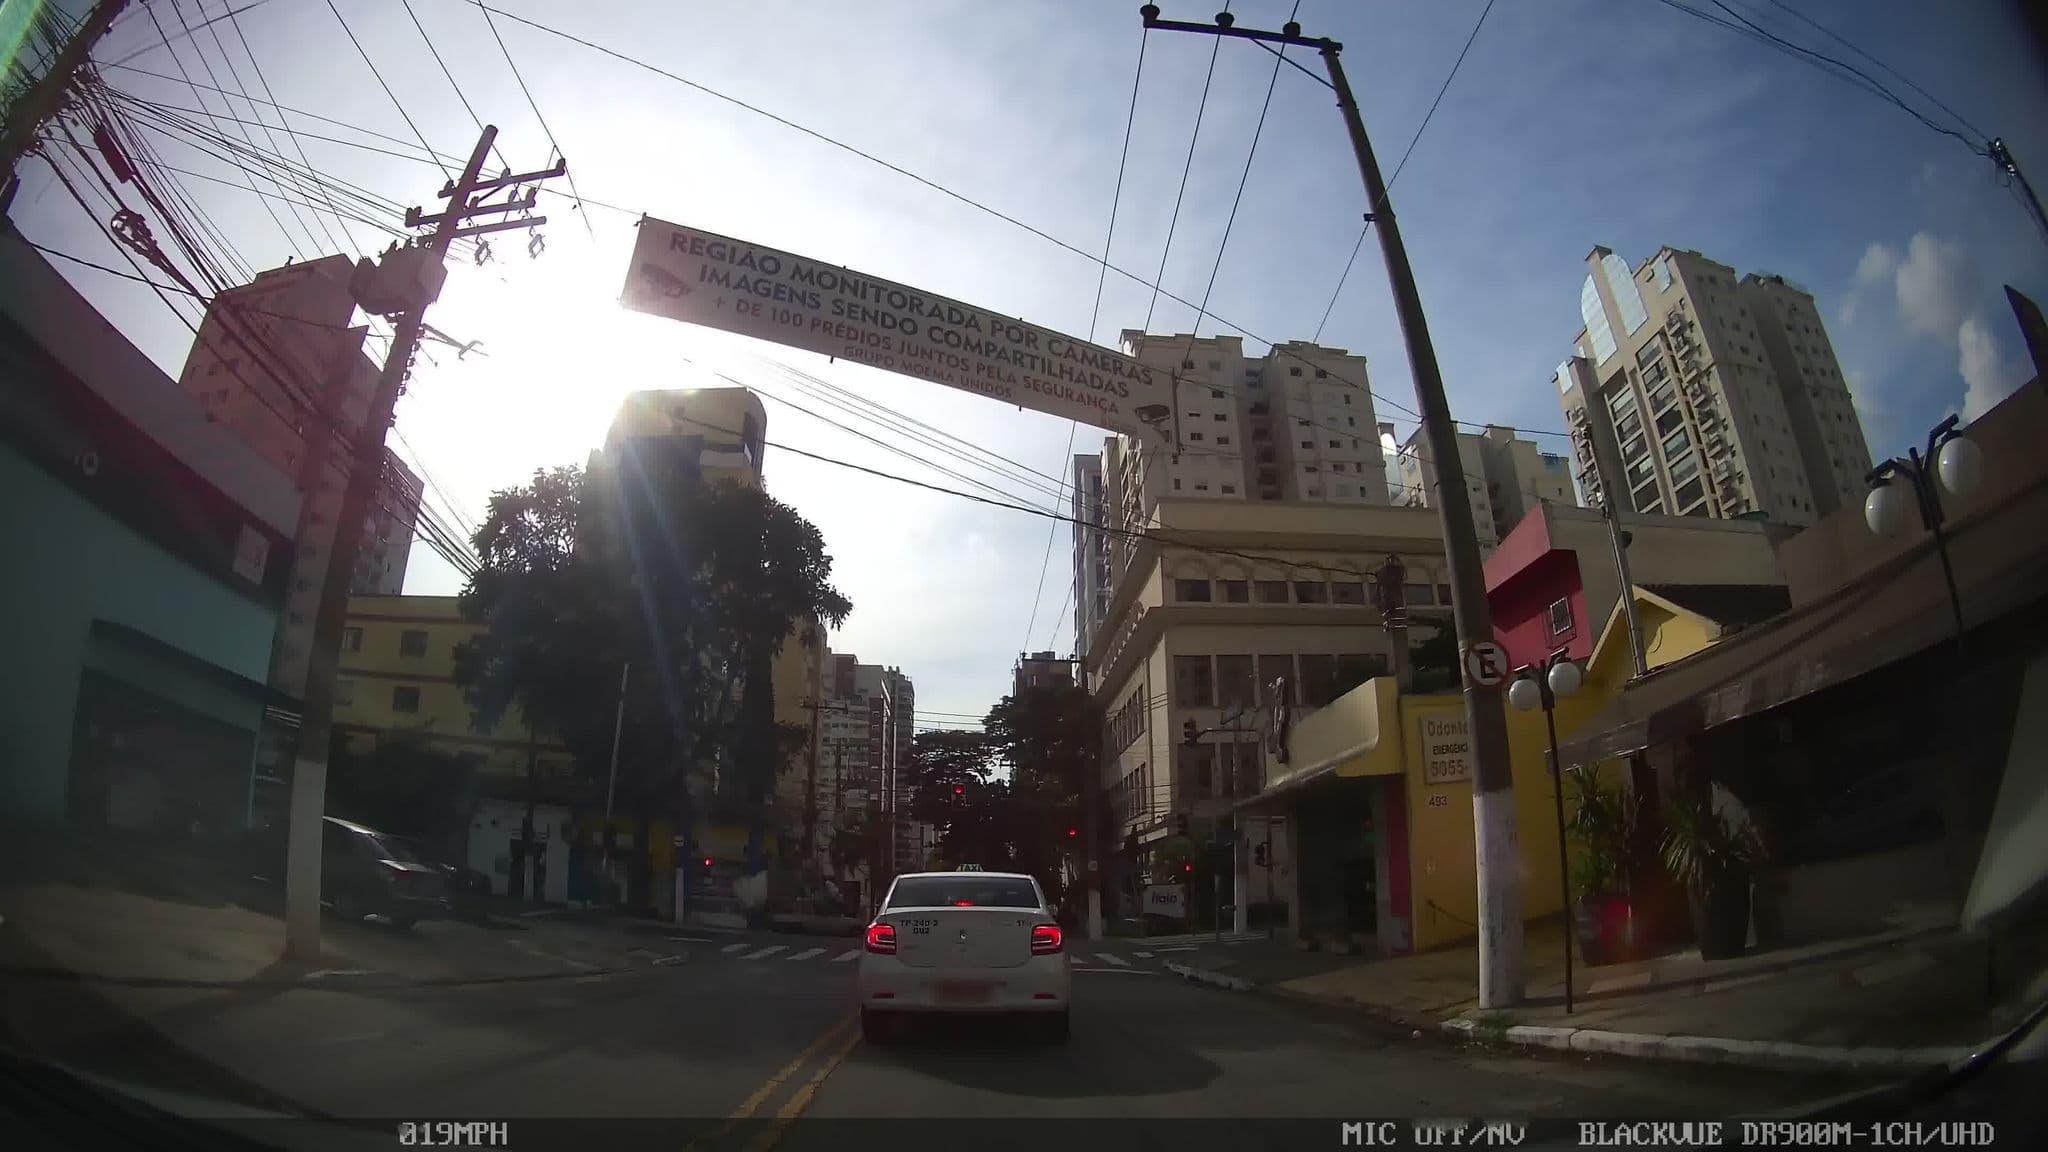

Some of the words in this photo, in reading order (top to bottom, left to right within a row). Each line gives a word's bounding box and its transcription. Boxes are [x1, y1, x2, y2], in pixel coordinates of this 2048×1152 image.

[699, 264, 821, 310] IMAGENS
[832, 298, 919, 336] SENDO
[928, 326, 1129, 398] COMPARTILHADAS
[790, 262, 982, 332] MONITORADA
[990, 320, 1039, 350] POR
[736, 299, 761, 317] DE
[772, 308, 802, 327] 100
[810, 317, 892, 350] PRÉDIOS
[900, 341, 970, 372] JUNTOS
[976, 362, 1017, 385] PELA
[1023, 376, 1119, 415] SEGURANÇA
[843, 345, 895, 367] GRUPO
[902, 360, 953, 382] MOEMA
[960, 376, 1012, 399] UNIDOS
[1480, 648, 1496, 678] E
[1429, 795, 1447, 807] 493
[959, 864, 981, 872] TAXI
